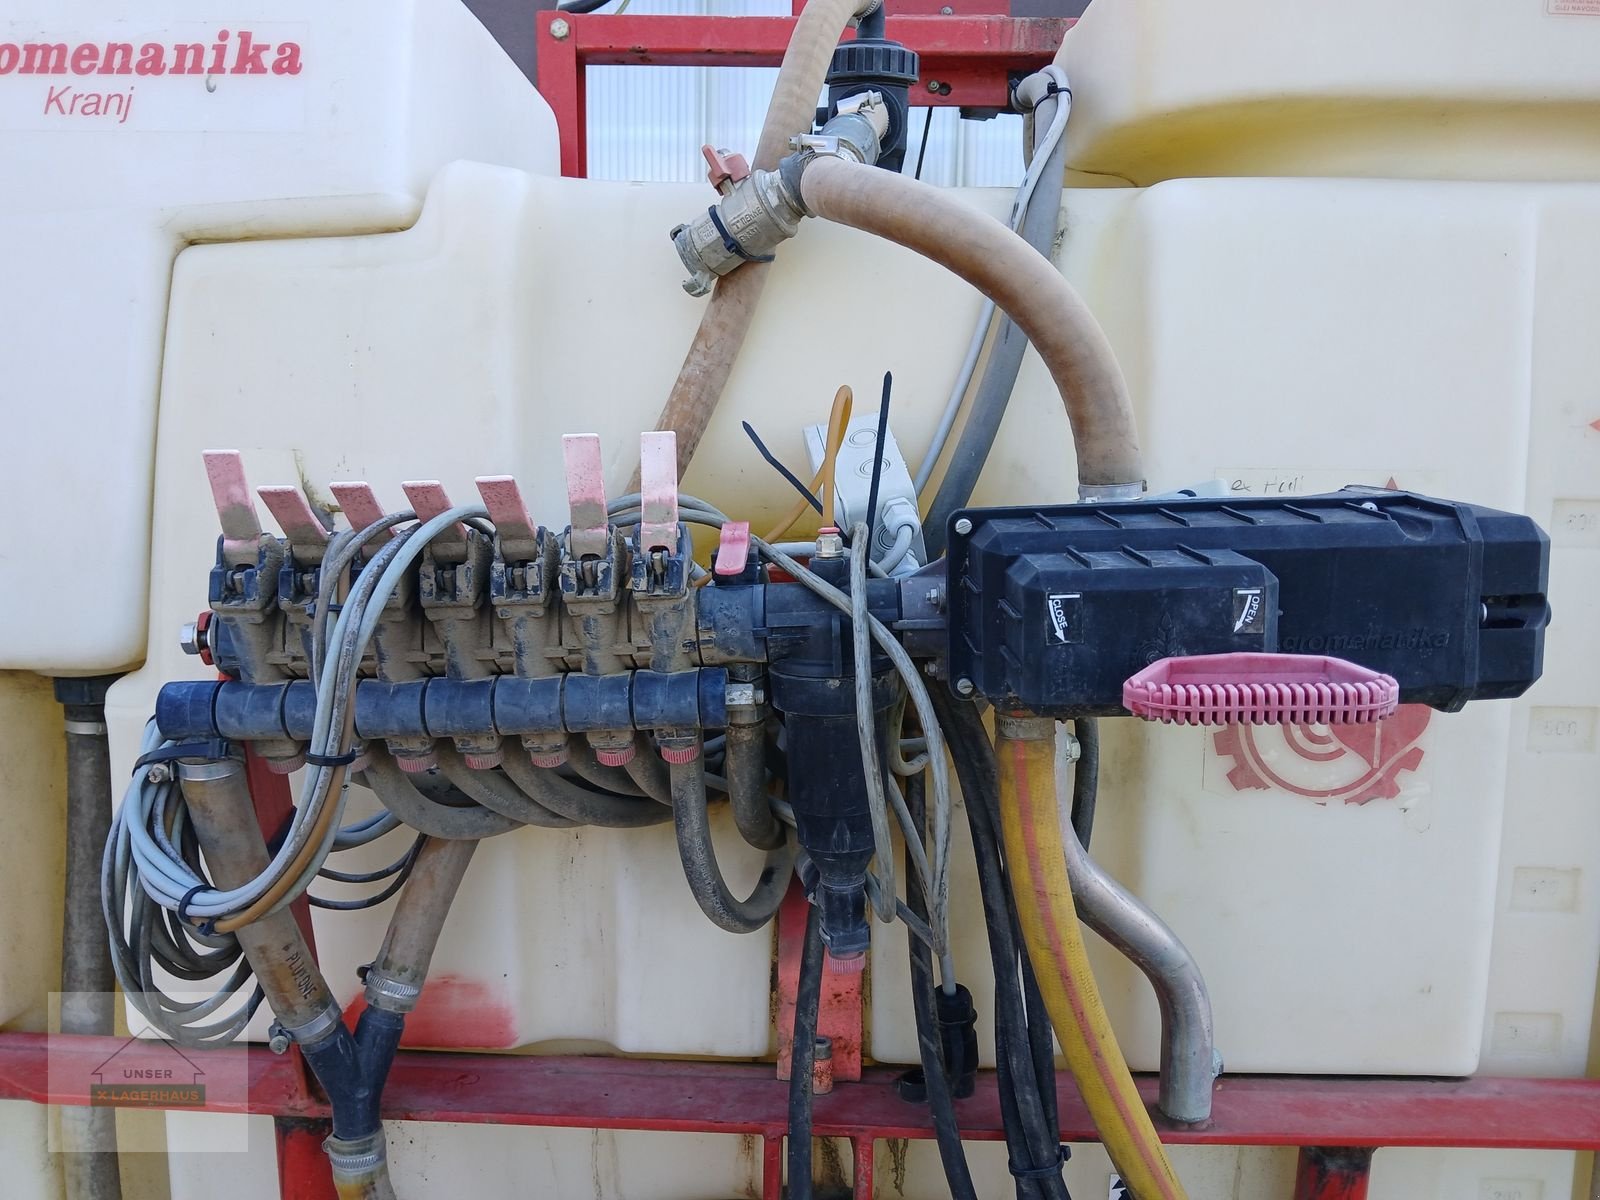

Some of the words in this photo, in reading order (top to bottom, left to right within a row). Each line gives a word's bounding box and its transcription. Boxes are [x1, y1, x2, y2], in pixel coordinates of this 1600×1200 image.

[44, 86, 135, 123] Kranj
[1052, 599, 1068, 630] CLOSE
[1245, 596, 1260, 624] OPEN
